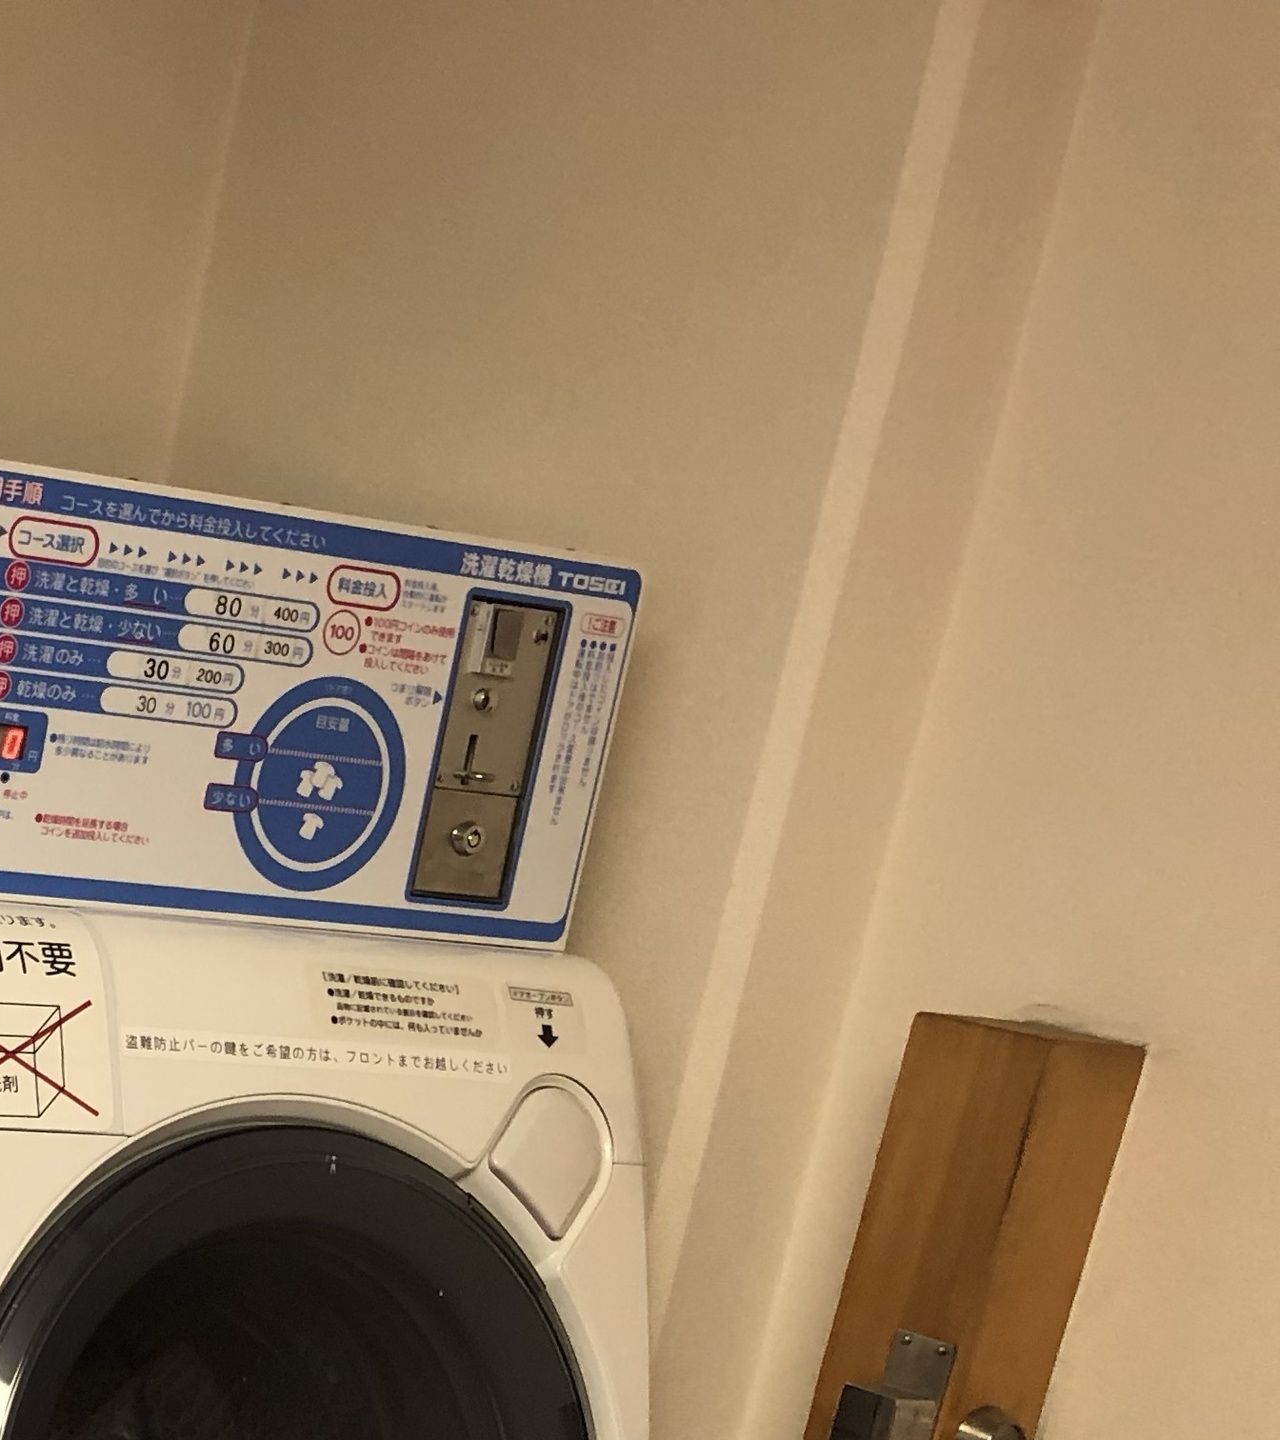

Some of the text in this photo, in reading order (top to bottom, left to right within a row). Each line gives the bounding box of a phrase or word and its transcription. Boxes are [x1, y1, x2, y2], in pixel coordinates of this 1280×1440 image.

[60, 494, 327, 550] コースを選んでから料金投入してください
[18, 528, 86, 555] コース選択
[337, 577, 388, 600] 料金投入
[460, 552, 627, 596] 洗濯乾燥機 TOSEI
[11, 566, 27, 585] 押
[215, 595, 242, 618] 80
[273, 606, 299, 624] 400
[300, 609, 310, 624] 円
[3, 602, 21, 622] 押
[208, 631, 235, 654] 60
[264, 640, 291, 657] 300
[292, 644, 304, 659] 円
[330, 624, 355, 641] 100
[23, 643, 83, 666] 洗濯のみ
[144, 657, 170, 681] 30
[196, 668, 222, 685] 200
[223, 670, 234, 686] 円
[17, 680, 77, 702] 乾燥のみ
[136, 695, 157, 714] 30
[186, 701, 211, 718] 100
[214, 707, 225, 721] 円
[315, 714, 350, 732] 目安量
[1, 728, 25, 759] 0
[212, 790, 251, 808] 少ない
